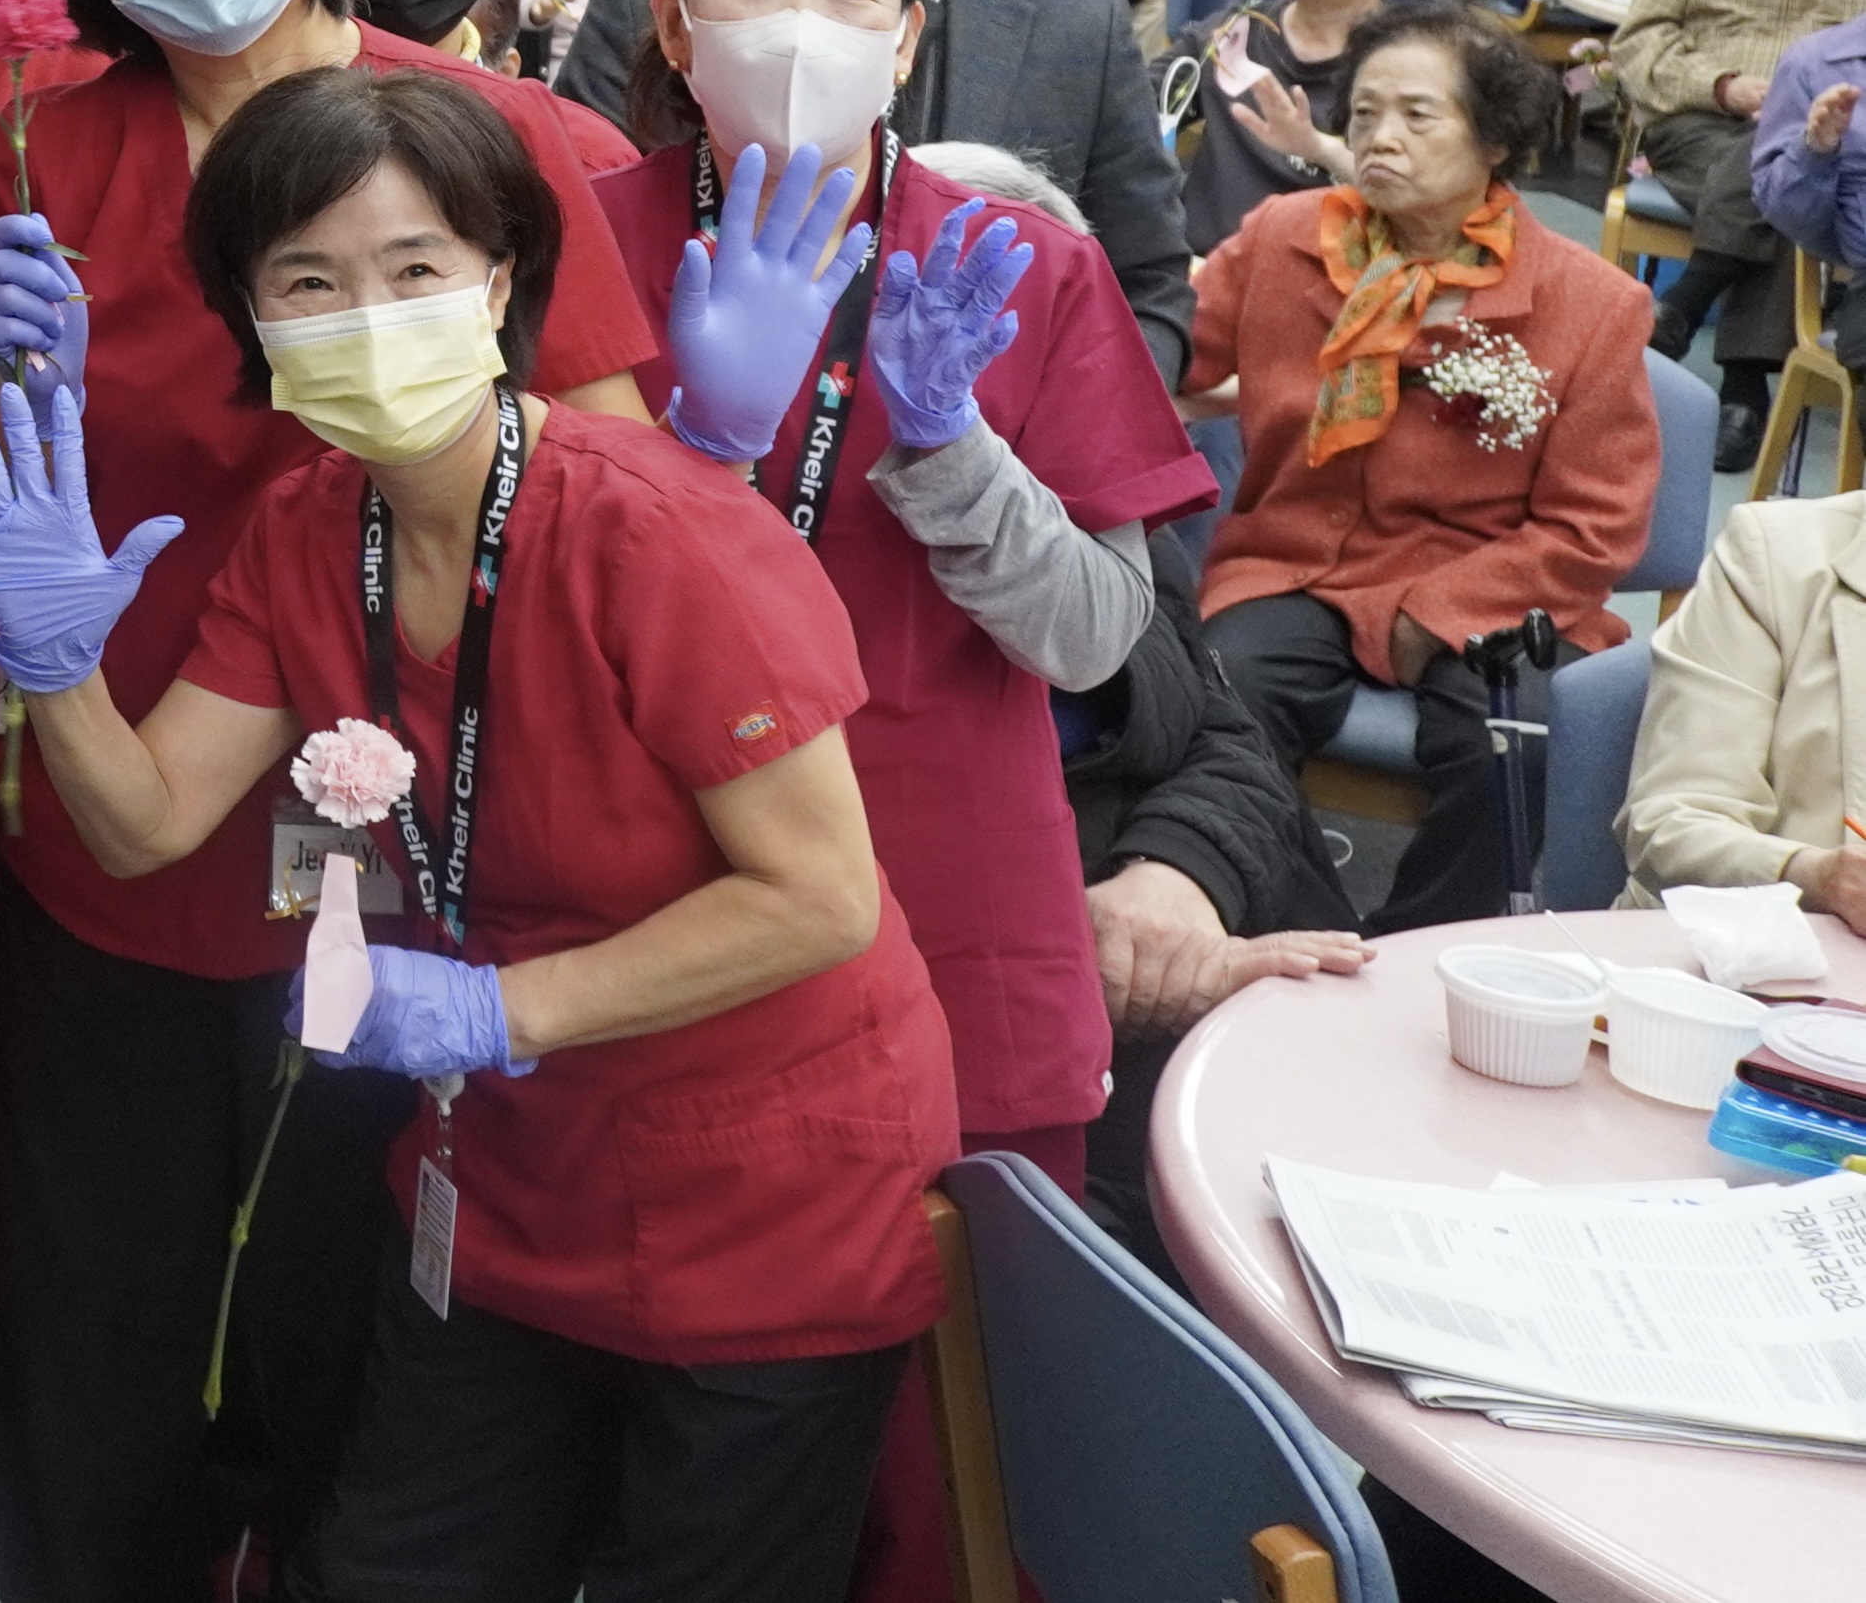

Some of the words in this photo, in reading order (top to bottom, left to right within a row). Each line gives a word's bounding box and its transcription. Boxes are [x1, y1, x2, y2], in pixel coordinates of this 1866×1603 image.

[483, 452, 518, 546] Kheir
[799, 414, 838, 500] Kheir
[364, 522, 384, 614] Clinic
[455, 706, 479, 799] Clinic
[395, 793, 429, 866] heir
[446, 802, 470, 896] Kheir
